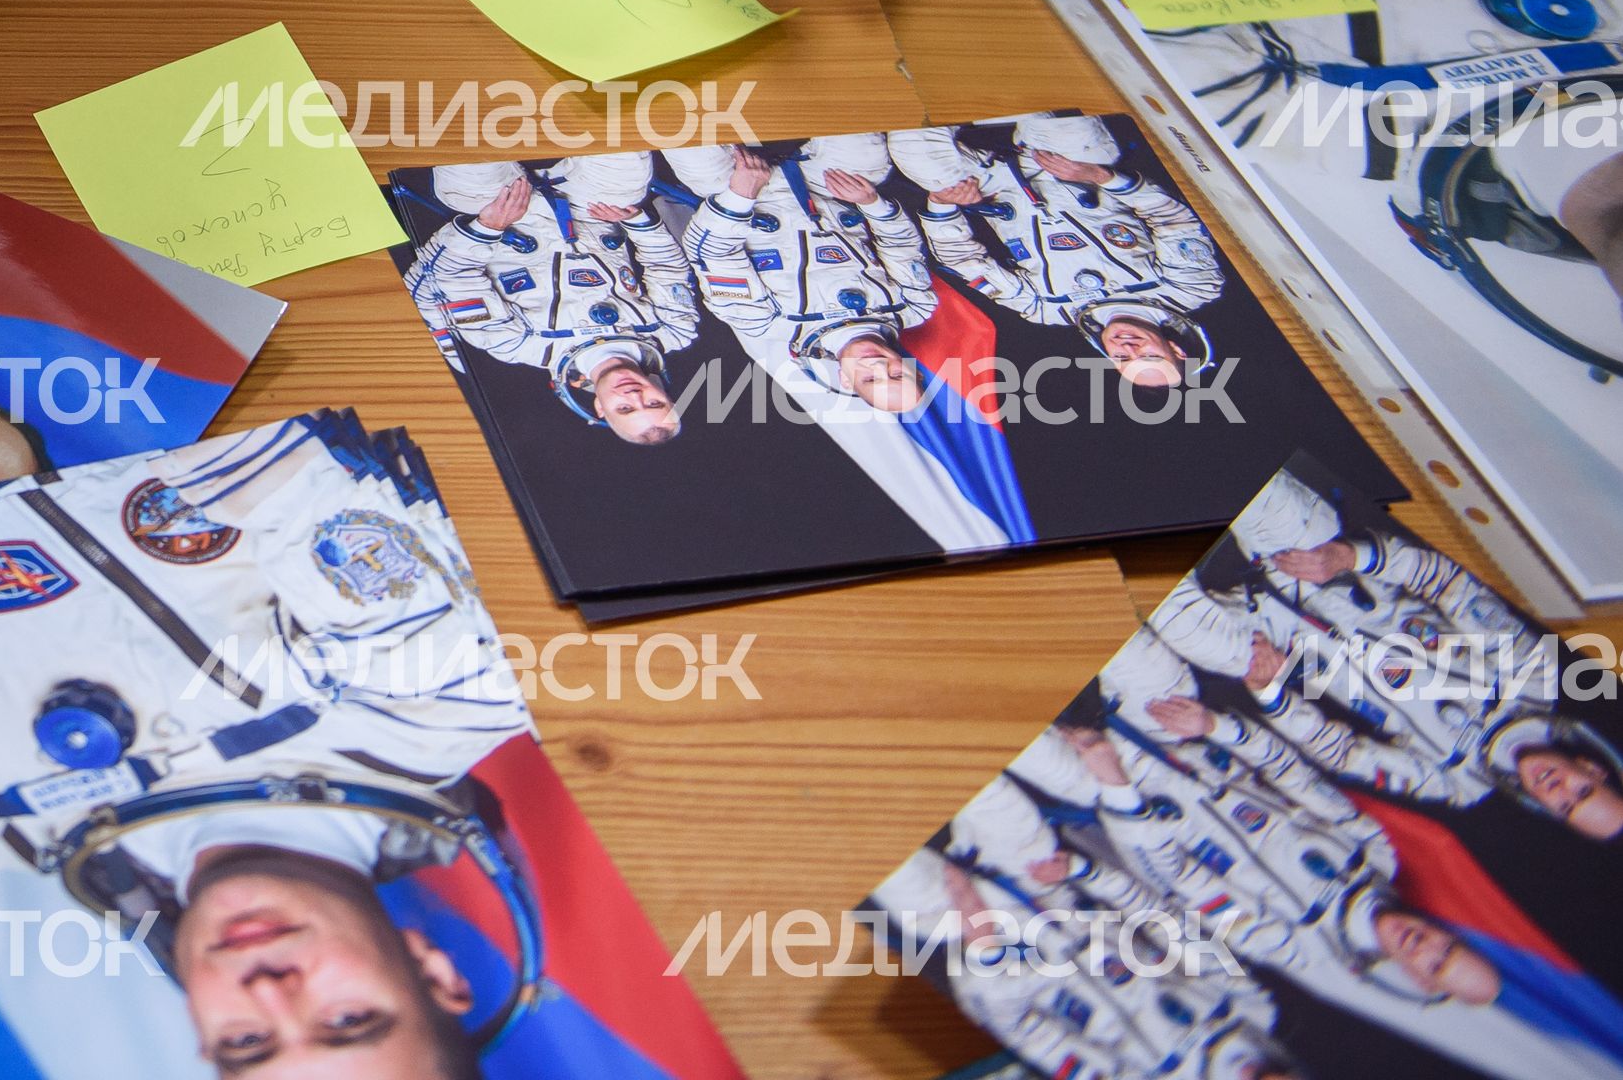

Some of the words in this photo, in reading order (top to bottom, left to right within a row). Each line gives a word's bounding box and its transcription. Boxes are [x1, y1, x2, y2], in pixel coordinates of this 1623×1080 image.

[1167, 125, 1211, 174] Berlingo
[156, 177, 288, 259] успехов
[257, 215, 352, 257] Берту
